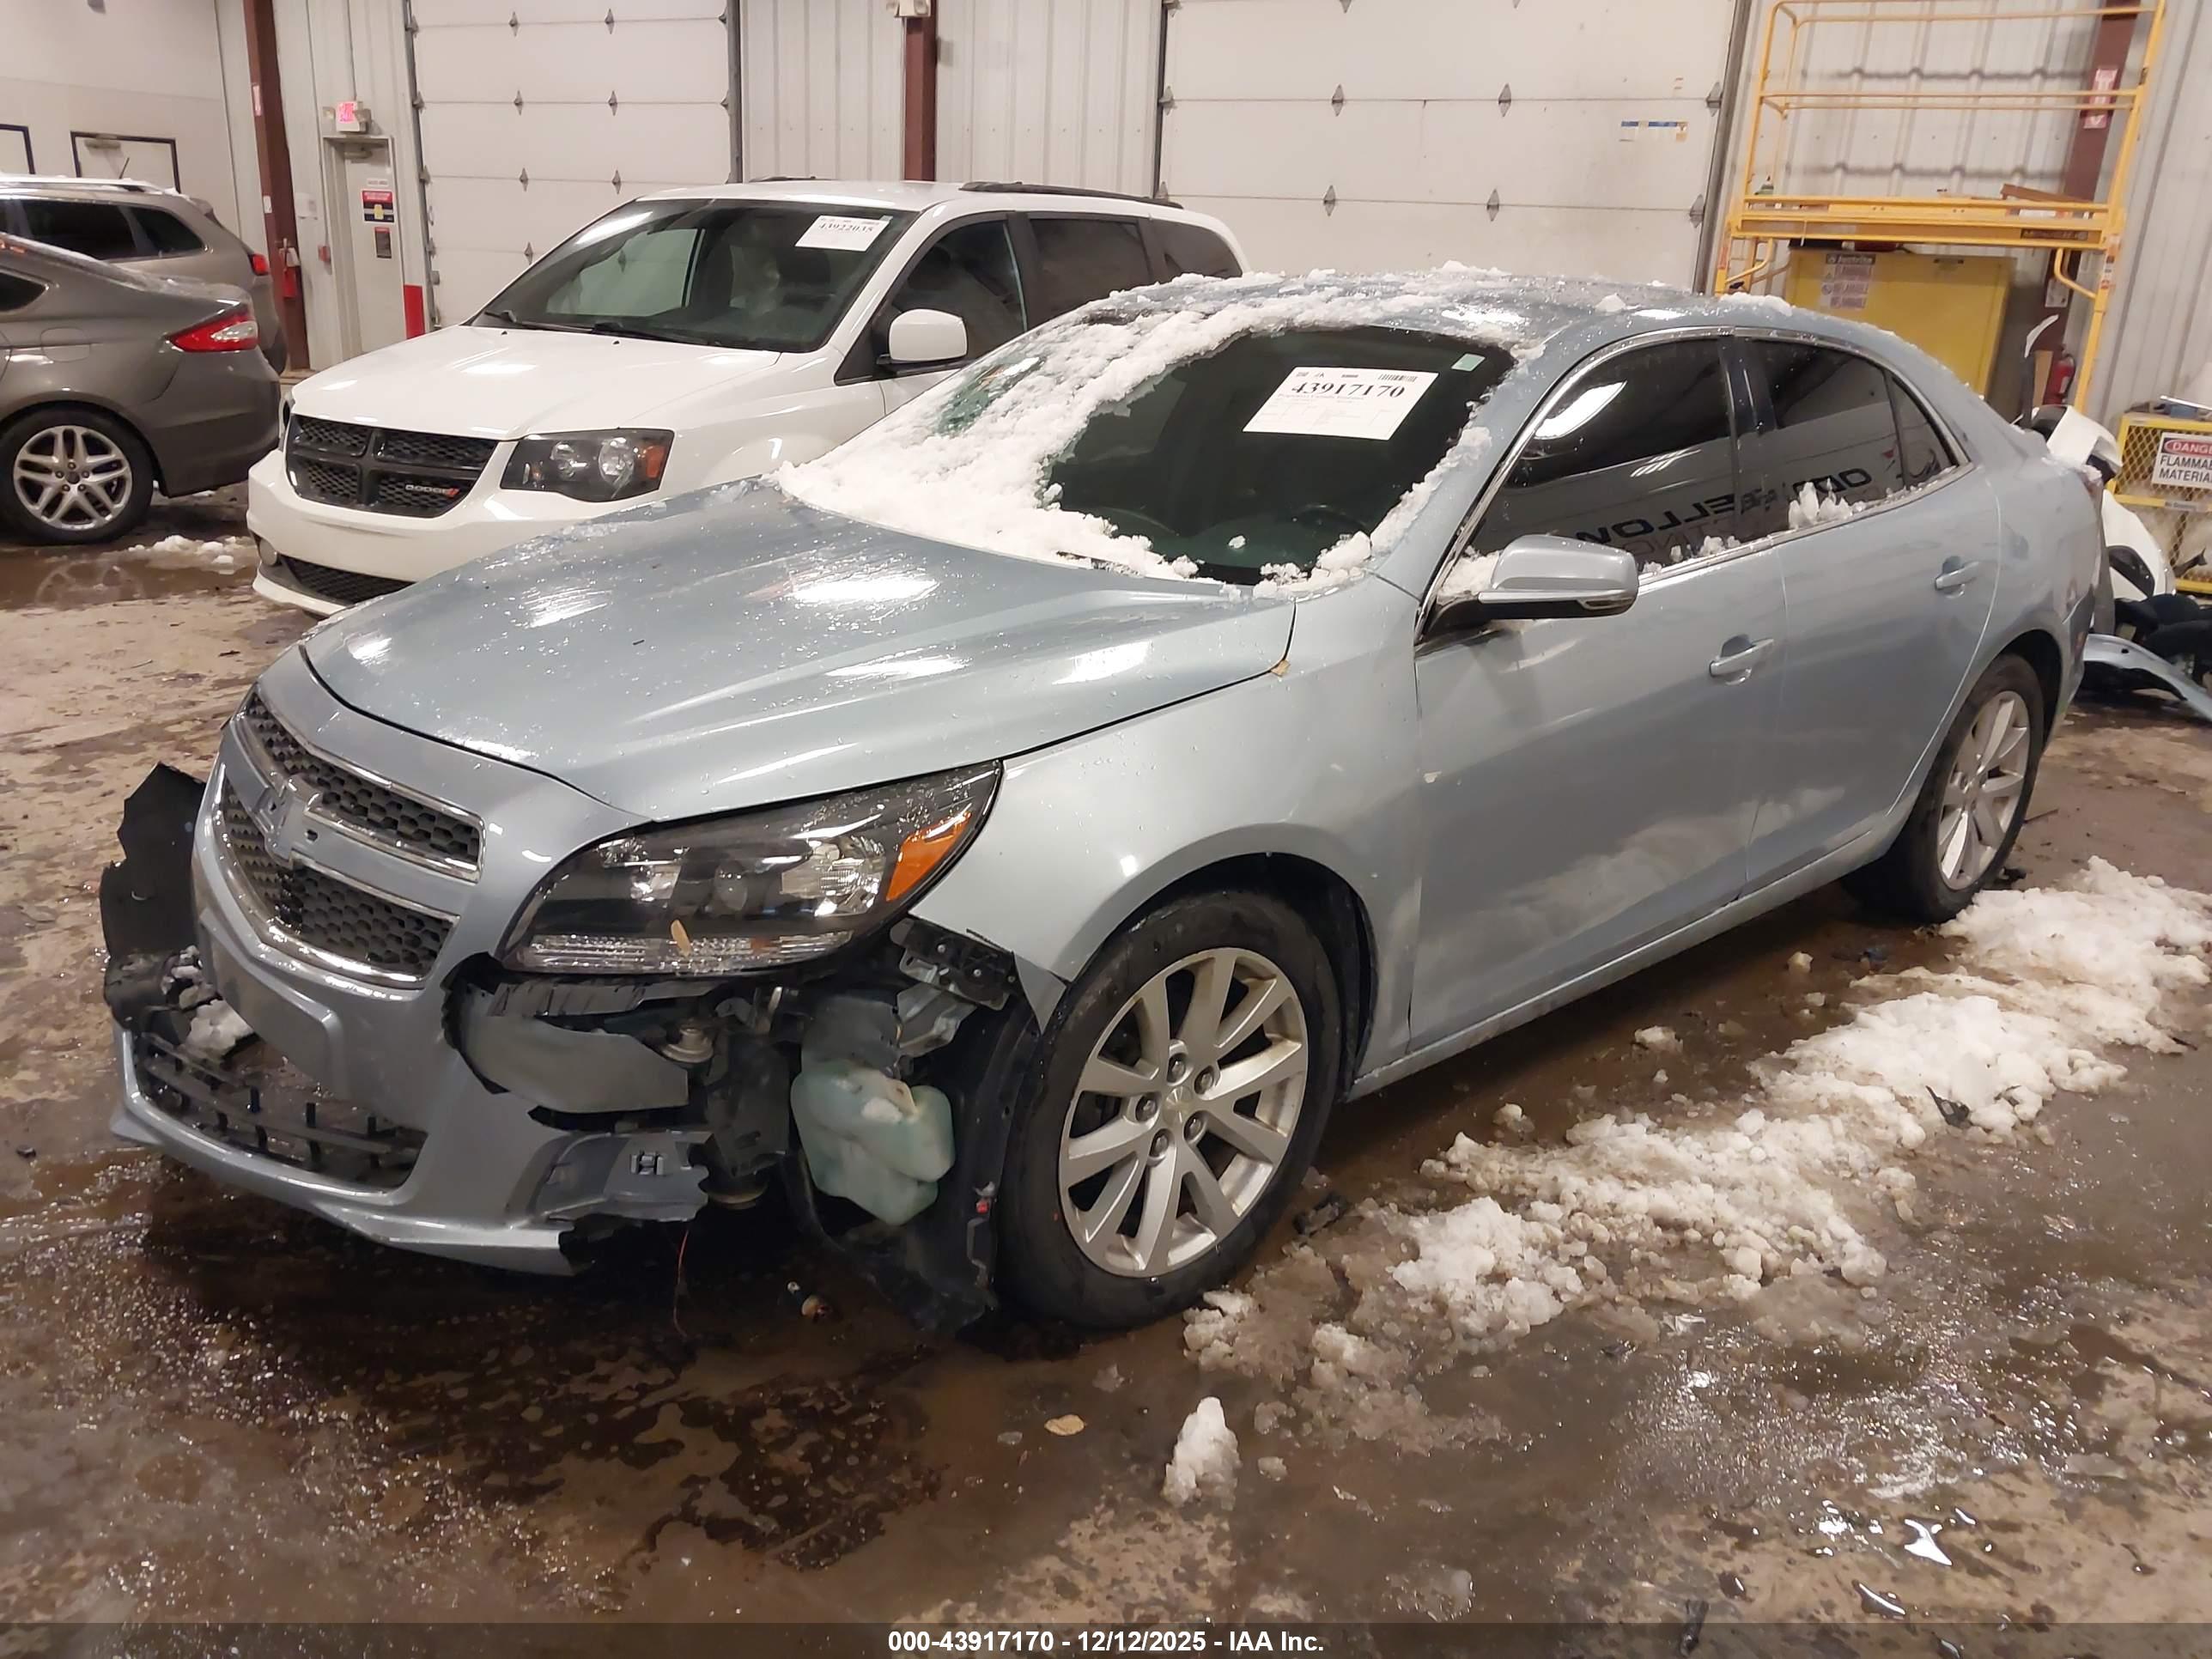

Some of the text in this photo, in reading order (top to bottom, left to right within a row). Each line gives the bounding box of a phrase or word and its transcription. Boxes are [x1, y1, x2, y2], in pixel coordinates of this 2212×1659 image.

[1291, 382, 1405, 398] 43917170
[2158, 468, 2212, 483] MATERIA
[405, 484, 450, 495] DODGE
